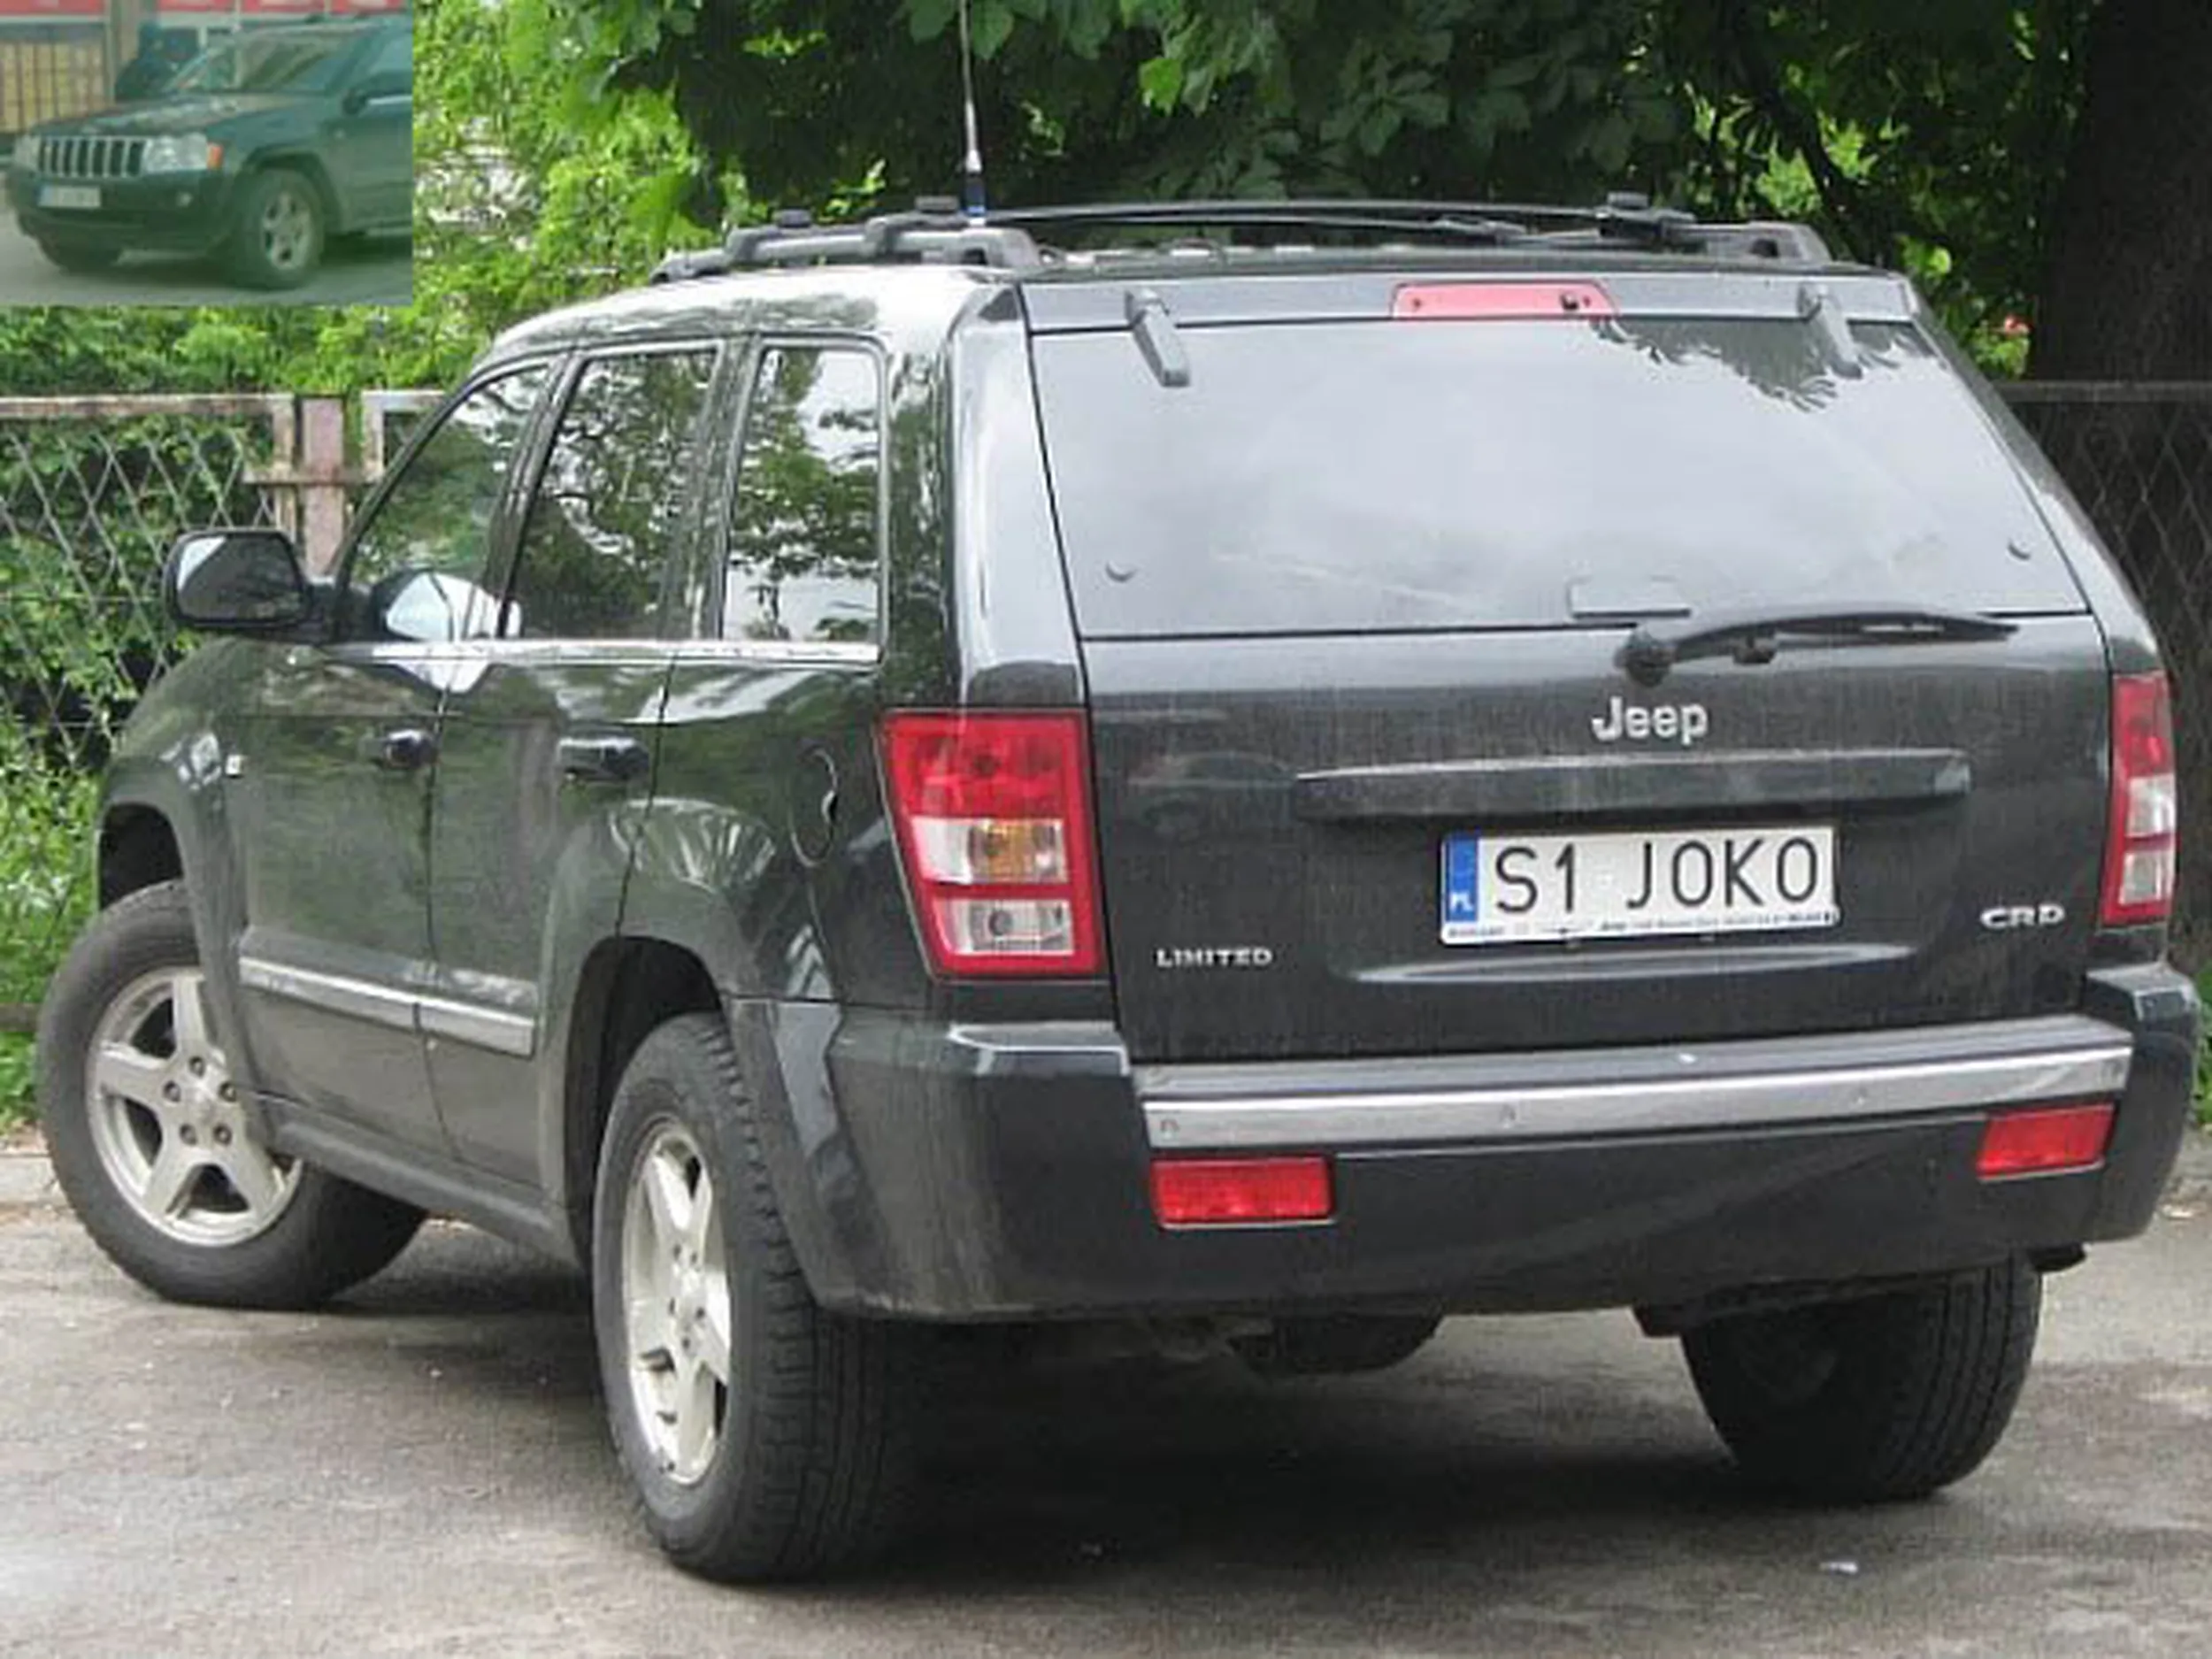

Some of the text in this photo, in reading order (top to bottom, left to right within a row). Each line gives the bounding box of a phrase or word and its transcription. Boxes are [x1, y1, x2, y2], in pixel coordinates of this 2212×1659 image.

[1591, 695, 1709, 745] Jeep
[1495, 837, 1818, 914] S1 JOKO
[1980, 903, 2065, 929] CRD
[1156, 947, 1273, 968] LIMITED
